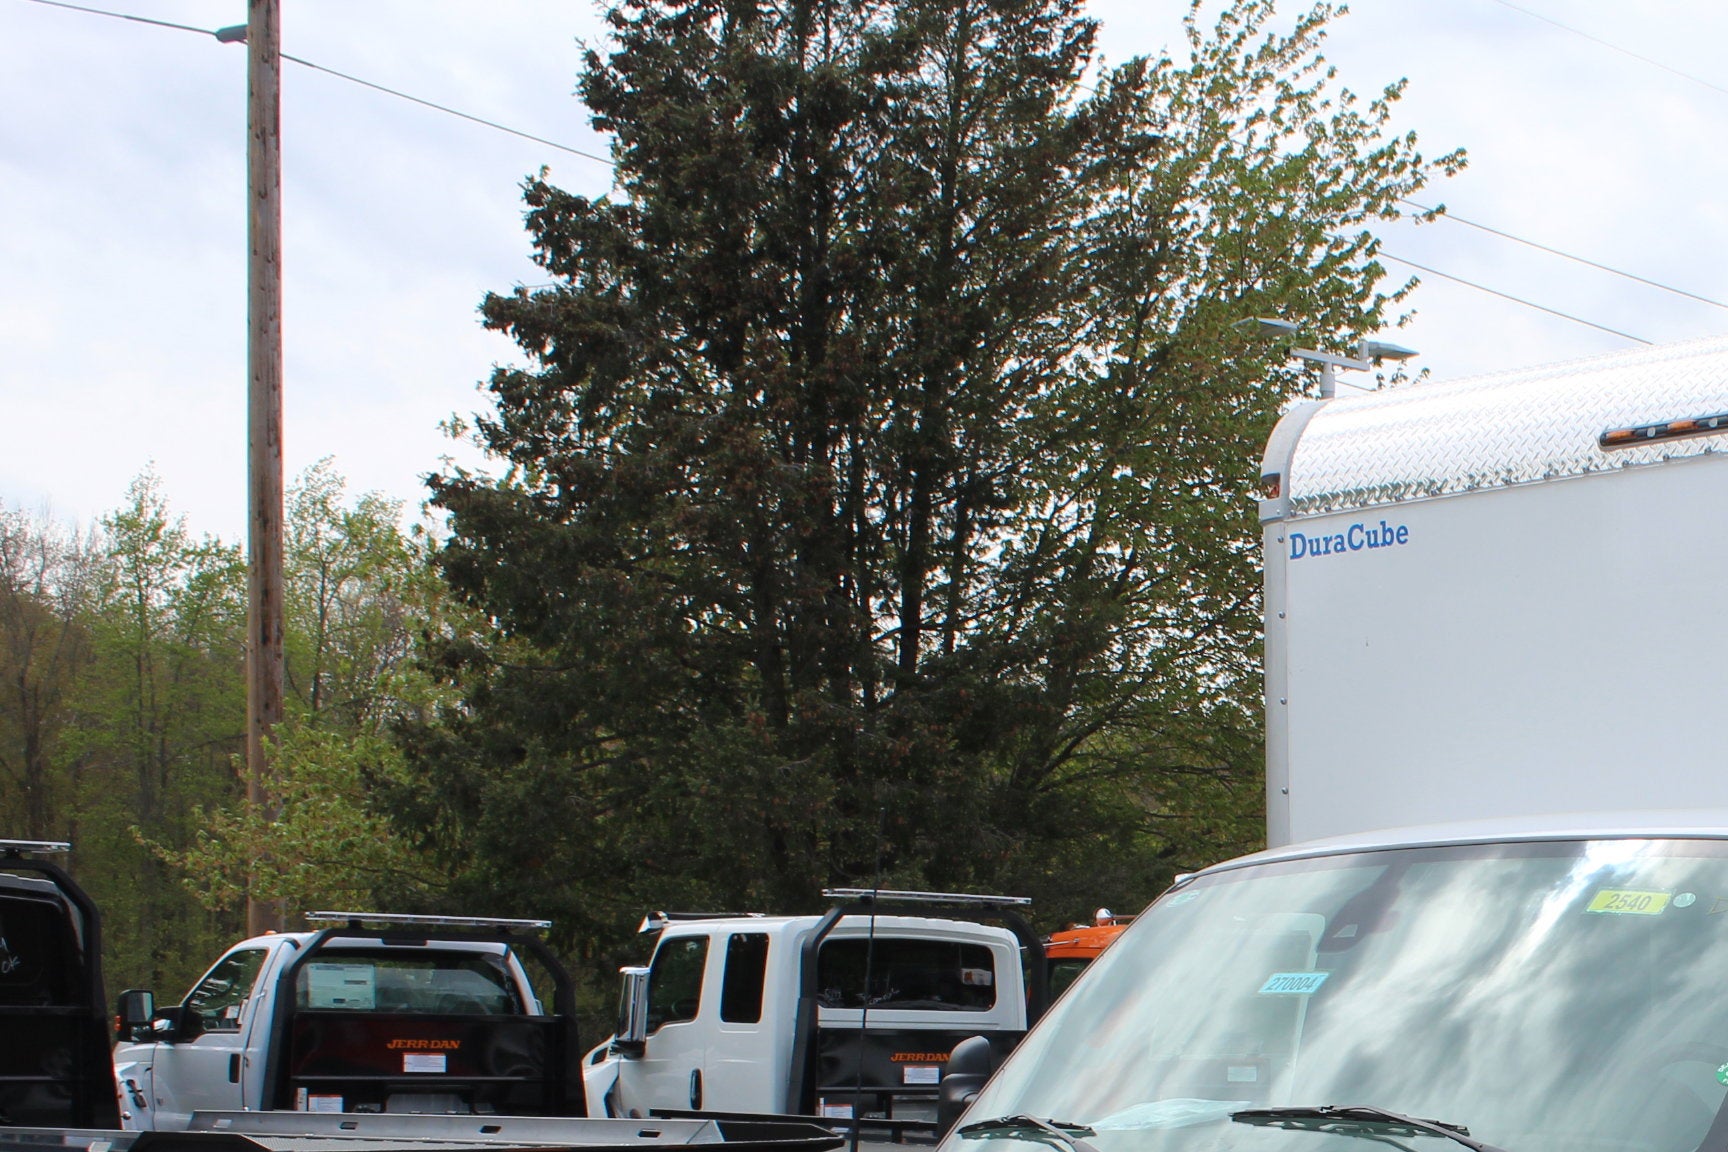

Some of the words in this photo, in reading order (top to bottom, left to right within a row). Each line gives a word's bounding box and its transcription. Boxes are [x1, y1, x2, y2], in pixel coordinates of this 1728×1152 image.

[1289, 520, 1409, 560] DuraCube
[1604, 893, 1652, 911] 2540
[1265, 976, 1318, 991] 270004
